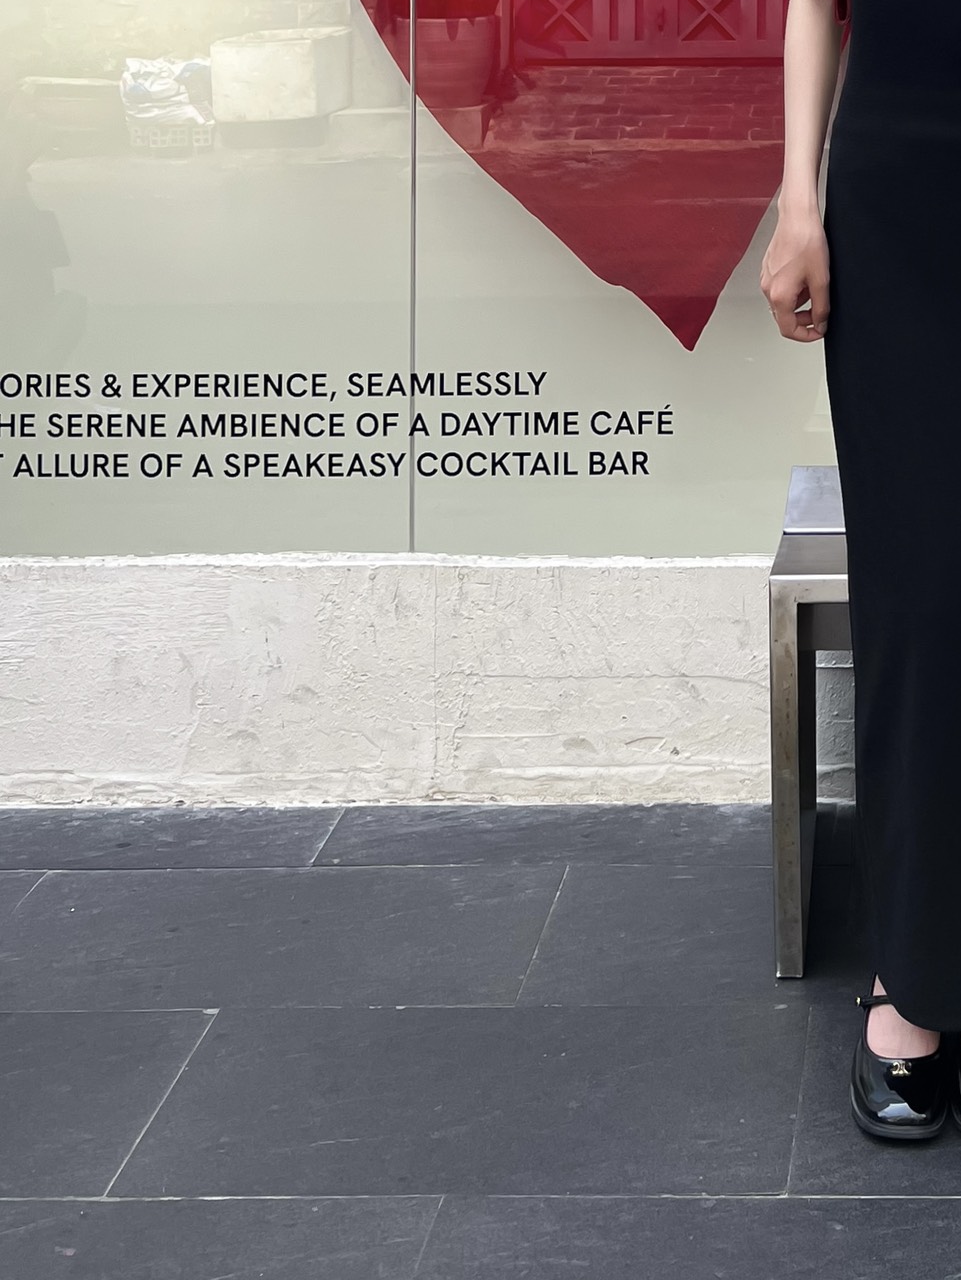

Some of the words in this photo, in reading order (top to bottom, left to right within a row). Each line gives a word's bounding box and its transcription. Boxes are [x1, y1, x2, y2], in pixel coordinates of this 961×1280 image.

[0, 373, 91, 398] ORIES
[102, 374, 123, 398] &
[133, 373, 337, 402] EXPERIENCE,
[347, 371, 548, 397] SEAMLESSLY
[47, 413, 166, 438] SERENE
[177, 413, 345, 438] AMBIENCE
[356, 413, 399, 437] OF
[409, 412, 430, 437] A
[441, 411, 580, 437] DAYTIME
[590, 404, 674, 436] CAFÉ
[13, 453, 129, 478] ALLURE
[140, 453, 183, 478] OF
[193, 453, 213, 478] A
[223, 452, 407, 478] SPEAKEASY
[416, 451, 579, 477] COCKTAIL
[589, 451, 650, 476] BAR
